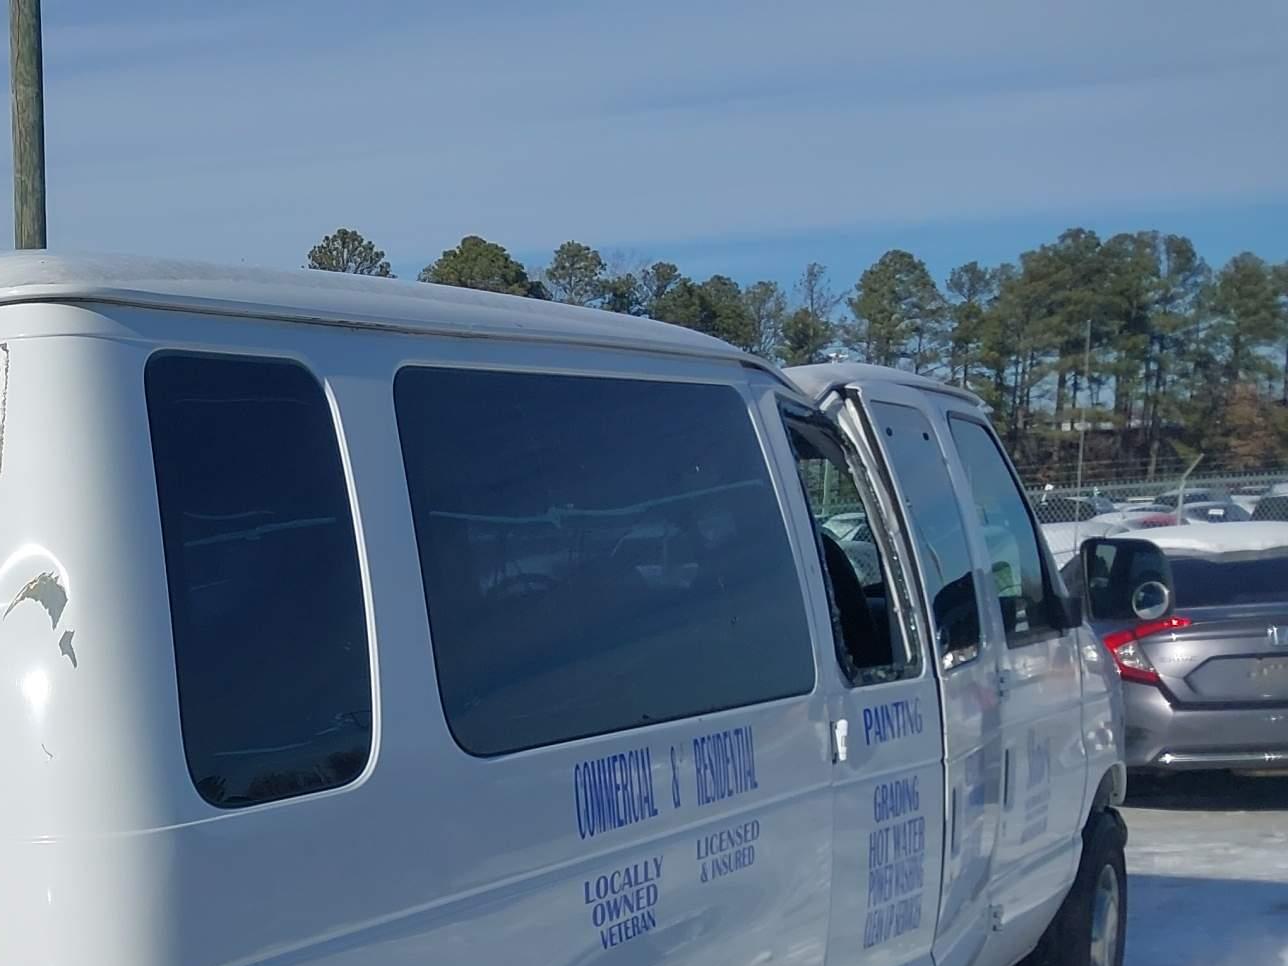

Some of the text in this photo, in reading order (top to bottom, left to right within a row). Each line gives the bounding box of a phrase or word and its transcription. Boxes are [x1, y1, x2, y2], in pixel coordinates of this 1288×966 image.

[863, 697, 923, 746] PAINTING
[574, 746, 658, 840] COMMERCIAL
[693, 725, 759, 807] RESIDENTIAL
[873, 775, 920, 823] GRADING
[696, 818, 761, 861] LICENSED
[868, 816, 926, 870] HOT WATER
[584, 855, 664, 905] LOCALLY
[699, 844, 756, 884] & INSURED
[591, 882, 659, 928] OWNED
[599, 909, 657, 950] VETERAN
